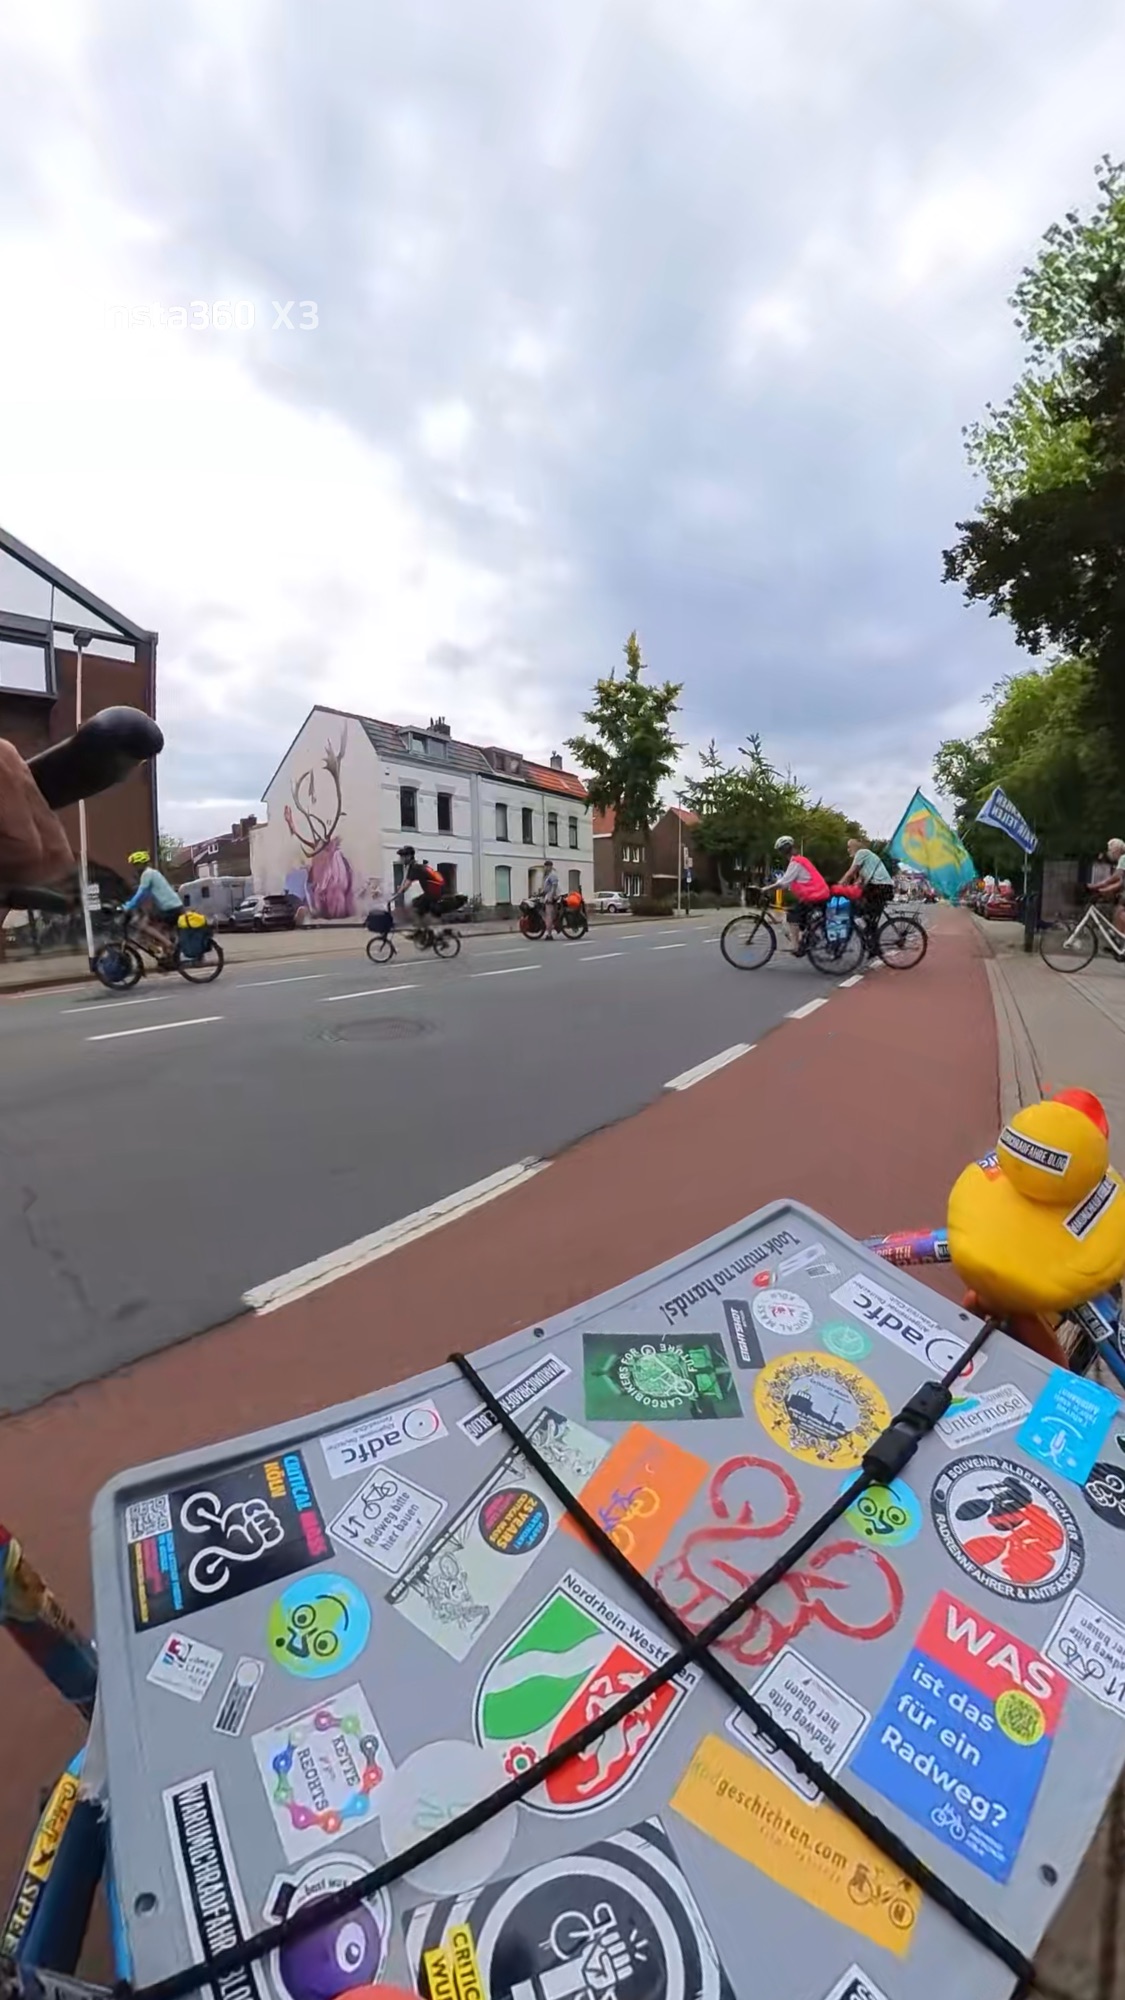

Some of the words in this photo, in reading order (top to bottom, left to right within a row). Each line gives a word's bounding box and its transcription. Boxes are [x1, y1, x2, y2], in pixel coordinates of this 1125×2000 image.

[659, 1278, 722, 1326] hands!
[853, 1293, 924, 1345] adfc
[620, 1347, 641, 1365] FOR
[659, 1343, 698, 1373] FUTURE
[465, 1357, 564, 1438] WARUMICHRADFAE.BLOG
[618, 1366, 684, 1409] CARGOBIKERS
[937, 1394, 1028, 1436] Untermosel
[341, 1431, 402, 1464] adfc
[949, 1456, 1000, 1480] SOUVENIR
[263, 1460, 287, 1499] KÖLN
[282, 1454, 312, 1511] CRITICAL
[363, 1511, 398, 1548] Radweg
[391, 1492, 410, 1512] bitte
[380, 1530, 399, 1551] hier
[393, 1504, 420, 1532] bauen
[522, 1497, 538, 1513] 25
[496, 1511, 529, 1550] YEARS
[935, 1512, 1015, 1598] RADRENNFAHRER
[1016, 1587, 1027, 1600] &
[1028, 1551, 1082, 1601] ANTIFASCHIST
[562, 1574, 696, 1686] Nordrhein-Westfen
[946, 1604, 1053, 1699] WAS
[1069, 1626, 1093, 1650] bitte
[1080, 1618, 1111, 1647] bauen
[768, 1688, 793, 1717] bitte
[784, 1679, 817, 1716] bauen
[912, 1662, 945, 1698] ist
[949, 1689, 996, 1733] das
[792, 1707, 837, 1756] Radweg
[816, 1709, 840, 1735] hier
[897, 1694, 936, 1731] für
[940, 1726, 981, 1767] ein
[332, 1733, 362, 1787] KETTE
[881, 1725, 1008, 1828] Radweg?
